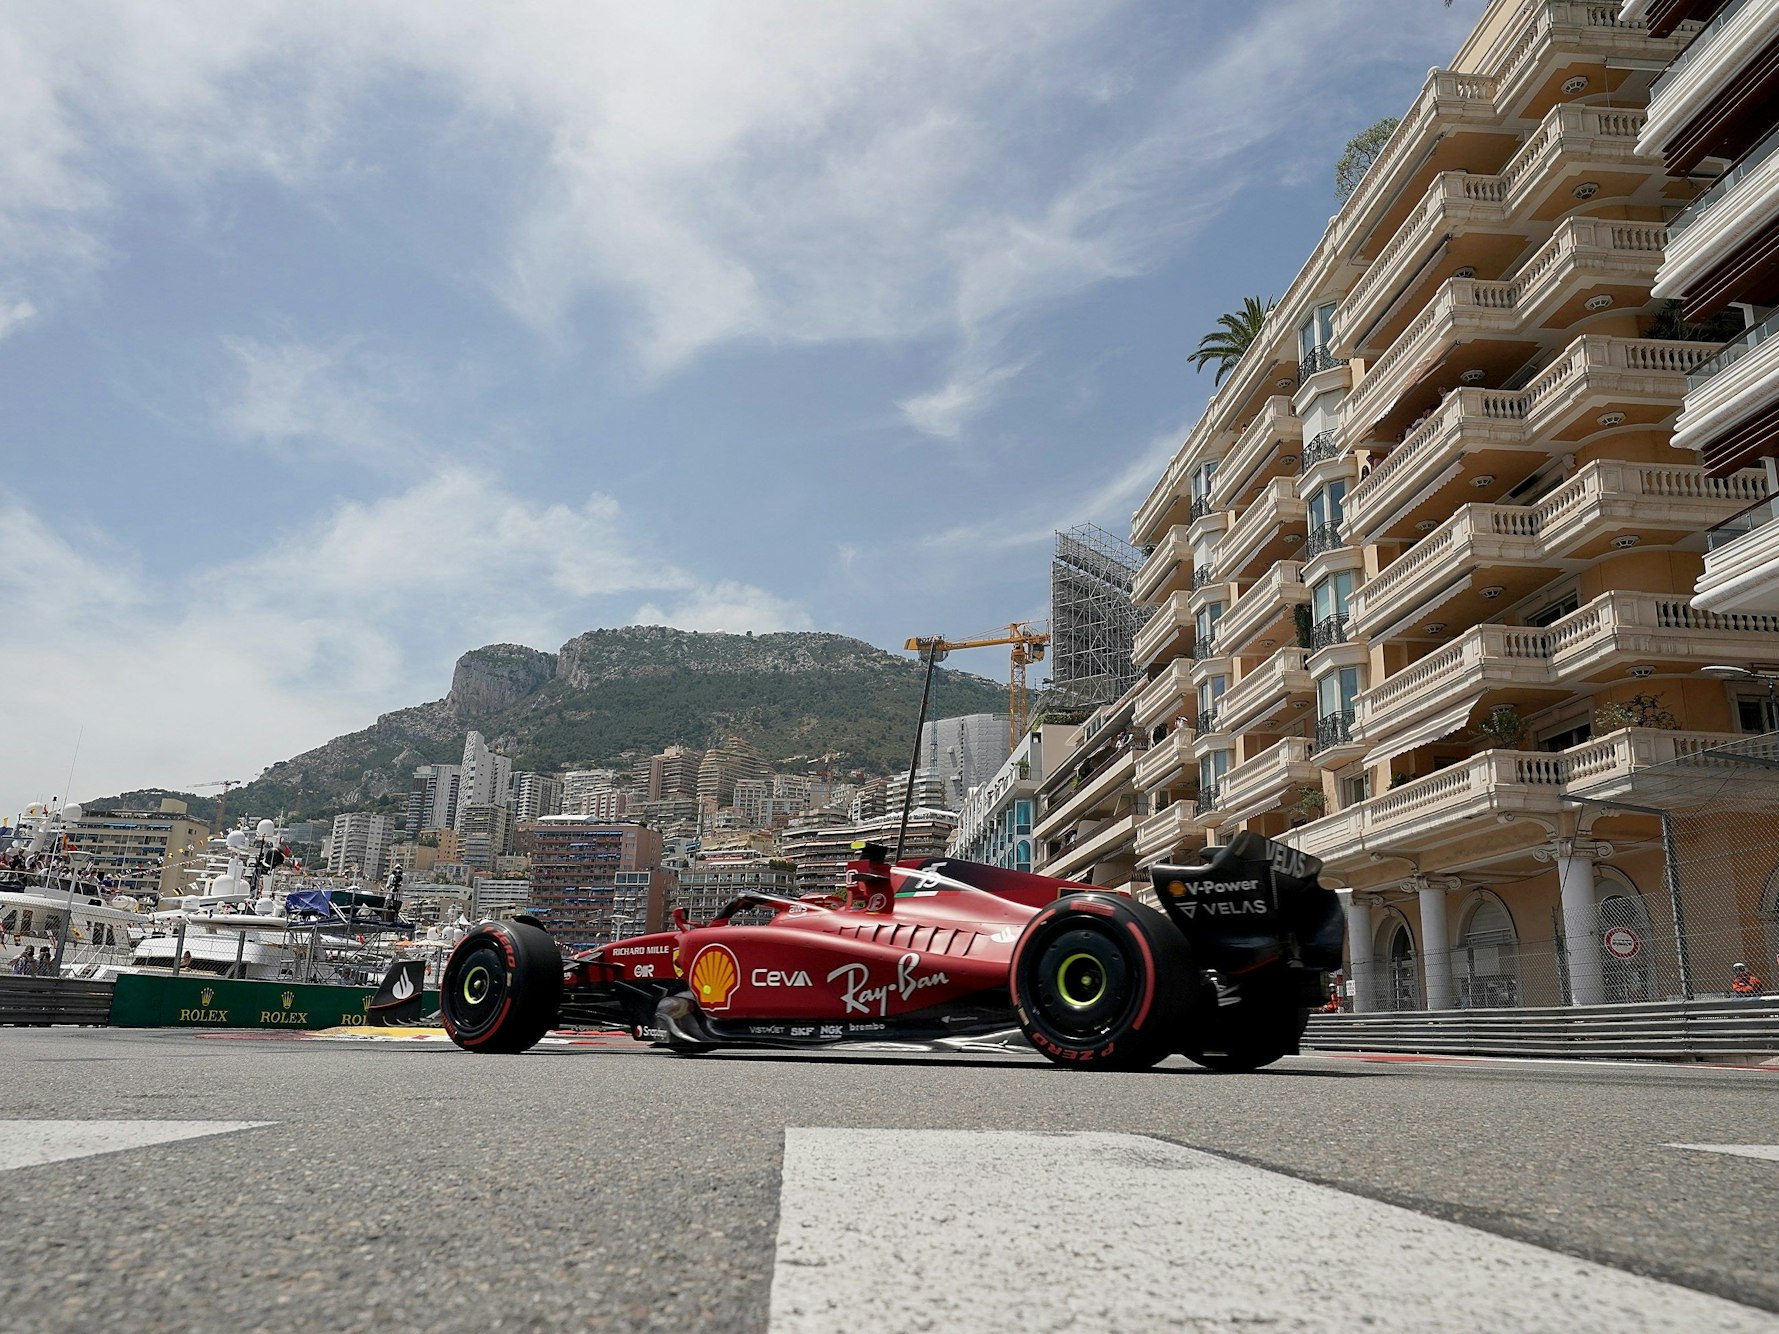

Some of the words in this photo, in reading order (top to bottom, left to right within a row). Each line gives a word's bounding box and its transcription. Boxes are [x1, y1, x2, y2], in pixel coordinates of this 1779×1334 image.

[1265, 840, 1306, 878] VELAS
[1185, 880, 1259, 895] V-Power
[1202, 900, 1268, 915] VELAS
[612, 948, 645, 956] RICHARD
[646, 946, 670, 954] MILLE
[180, 1009, 228, 1022] ROLEX
[260, 1011, 309, 1024] ROLEX
[340, 1014, 368, 1026] ROL
[790, 1027, 815, 1036] SKF
[820, 1025, 844, 1034] NGK
[849, 1022, 885, 1031] brembo
[1031, 1031, 1095, 1061] ZERO
[1101, 1042, 1114, 1057] P
